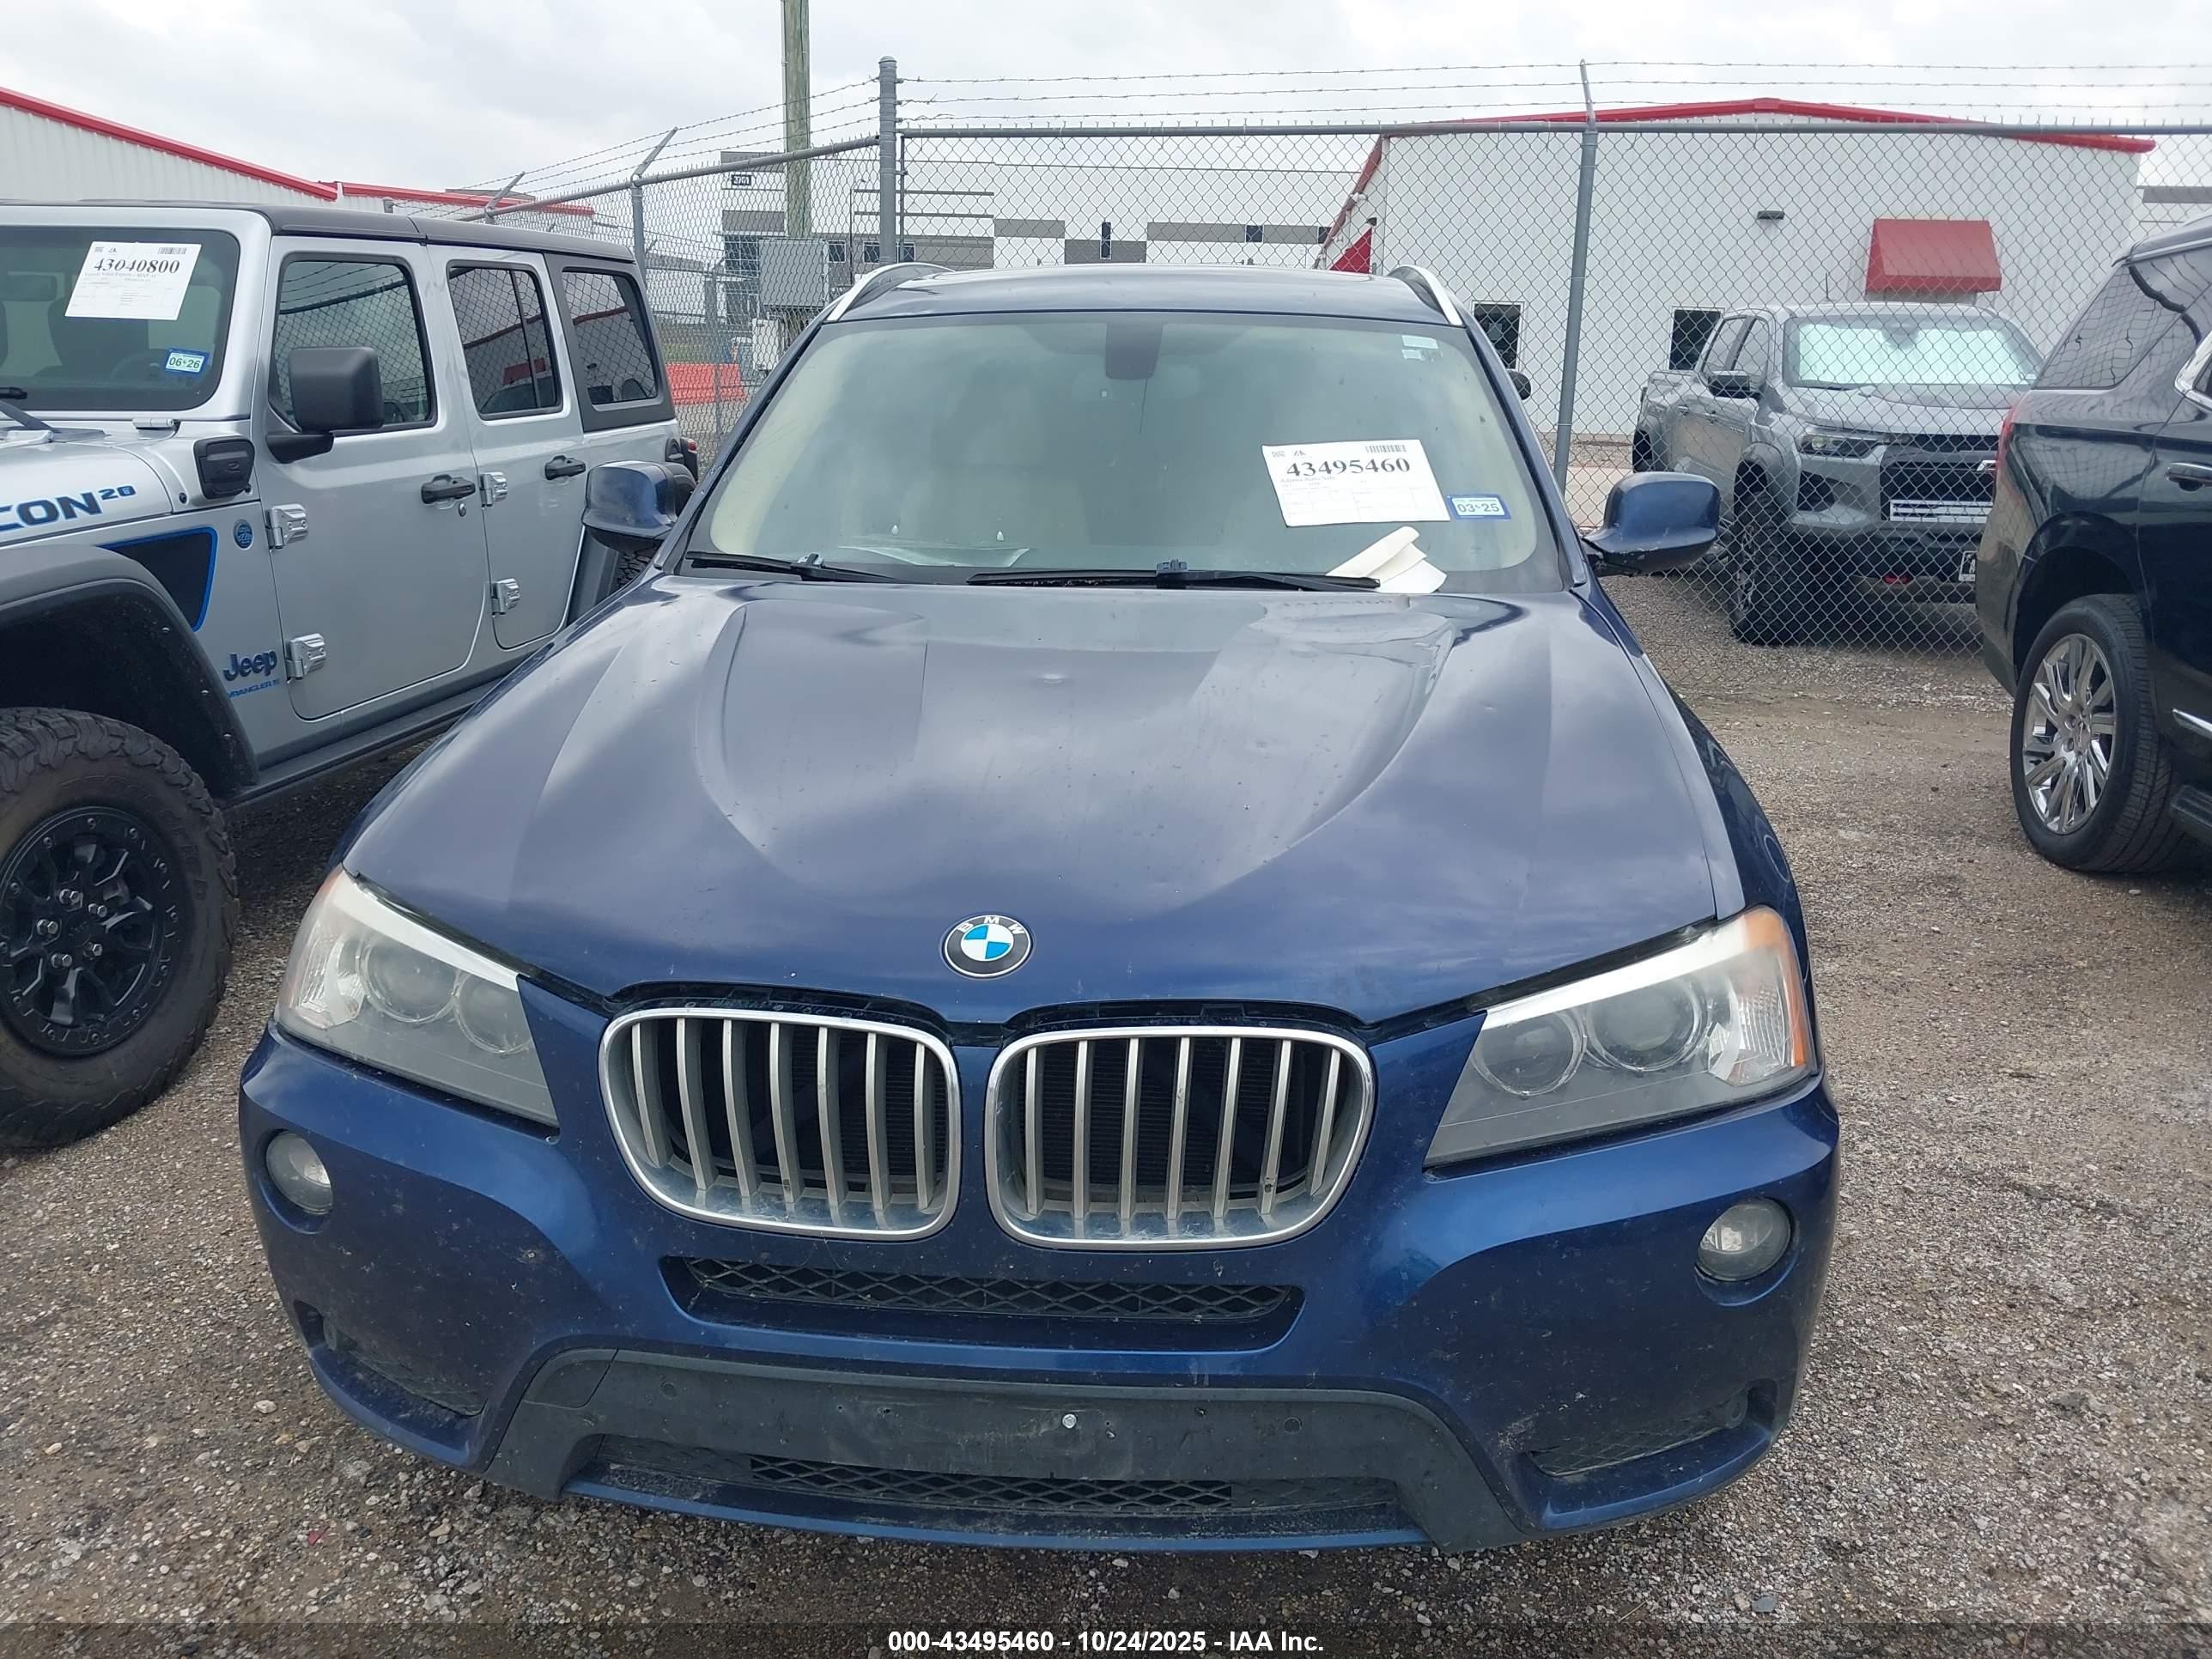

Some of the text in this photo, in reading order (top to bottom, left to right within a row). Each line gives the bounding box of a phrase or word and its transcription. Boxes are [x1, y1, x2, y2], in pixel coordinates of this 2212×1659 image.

[94, 258, 180, 274] 43040800
[1286, 457, 1411, 477] 43495460
[223, 651, 277, 681] Jeep
[957, 915, 1025, 934] BMW
